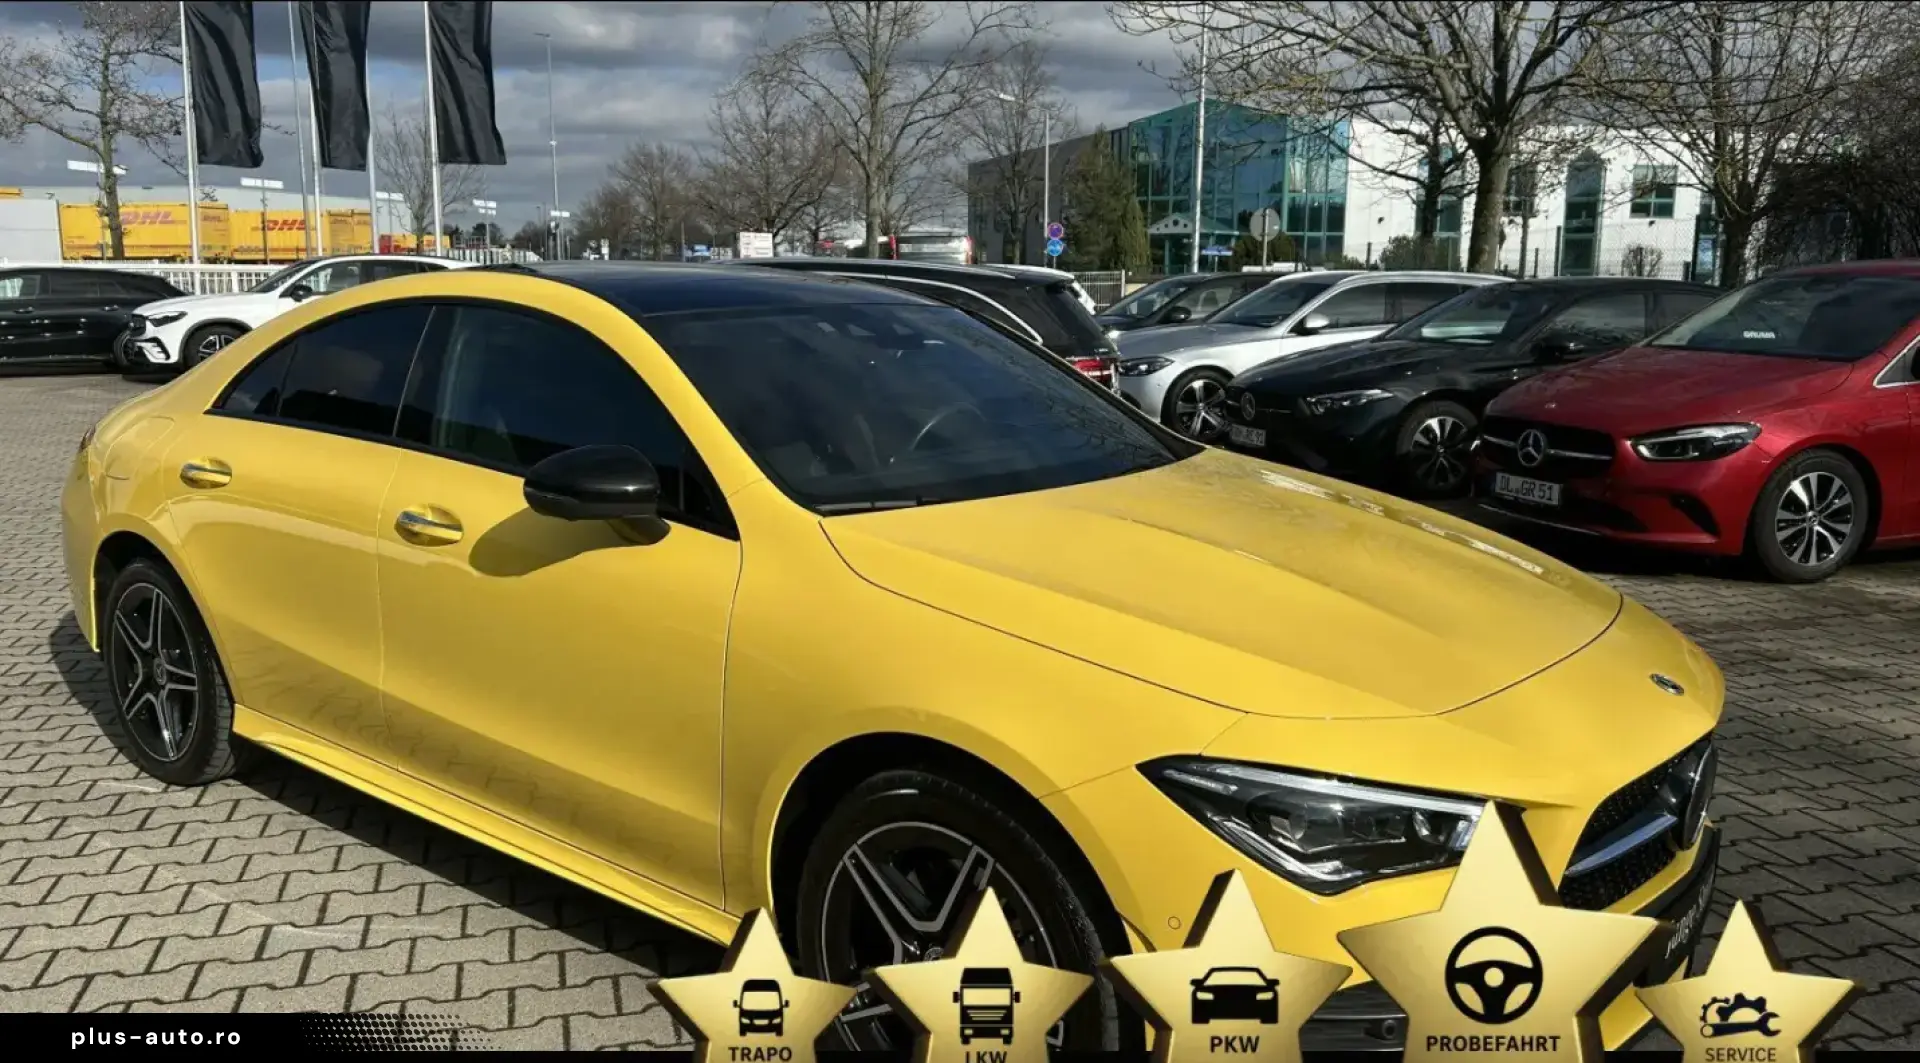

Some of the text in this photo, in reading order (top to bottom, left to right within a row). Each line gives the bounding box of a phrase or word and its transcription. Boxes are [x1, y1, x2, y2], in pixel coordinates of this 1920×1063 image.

[120, 211, 174, 225] DHL
[1500, 475, 1554, 502] DL GR 51
